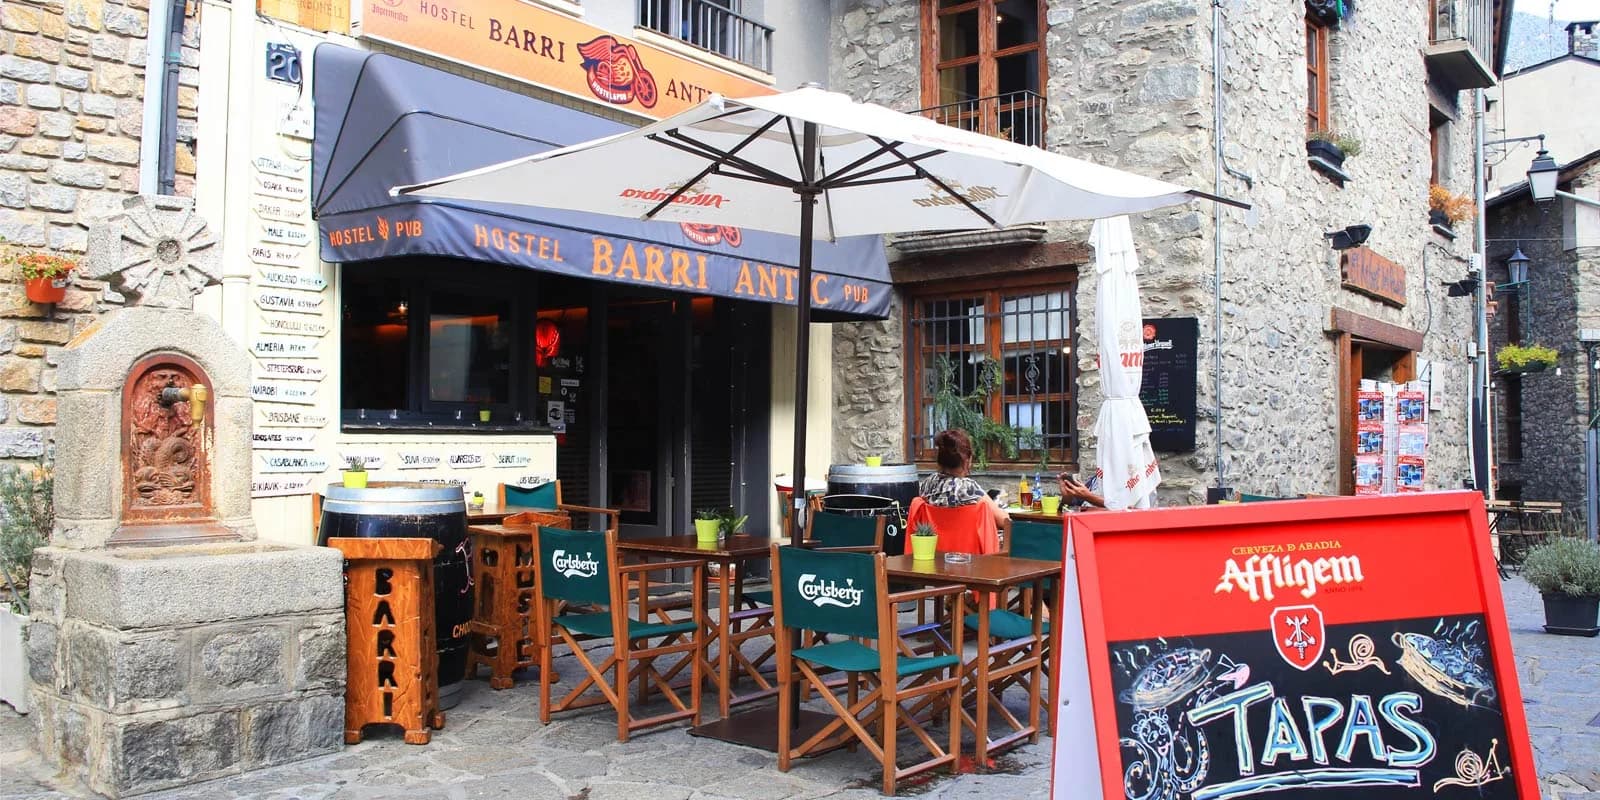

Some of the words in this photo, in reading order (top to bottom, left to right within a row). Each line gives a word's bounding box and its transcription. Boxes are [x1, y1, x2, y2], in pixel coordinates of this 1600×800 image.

[420, 2, 476, 30] HOSTEL
[488, 18, 566, 63] BARRI
[665, 78, 726, 104] ANT
[270, 52, 301, 84] 20
[263, 181, 282, 192] OSAKA
[258, 203, 281, 216] DAKAR
[267, 228, 284, 239] MALE
[329, 225, 374, 248] HOSTEL
[395, 218, 424, 238] PUB
[252, 247, 271, 259] PARIS
[473, 223, 564, 263] HOSTEL
[592, 236, 708, 290] BARRI
[734, 262, 830, 305] ANTC
[843, 283, 870, 305] PUB
[266, 272, 297, 285] AUCKLAND
[260, 294, 294, 308] GUSTAVIA
[270, 319, 301, 331] HONOLULU
[256, 342, 284, 352] ALMERIA
[252, 385, 277, 396] NAIROBI
[268, 411, 301, 424] BRISBANE
[270, 457, 308, 468] CASABLANCA
[404, 455, 419, 464] SUVA
[1232, 545, 1284, 556] CERVEZA
[1299, 540, 1342, 551] ABADIA
[553, 549, 599, 577] Carlsberg
[1214, 553, 1365, 602] Affligem
[798, 573, 863, 606] Carlsberg
[372, 567, 398, 720] BARRI
[1187, 681, 1437, 776] TAPAS
